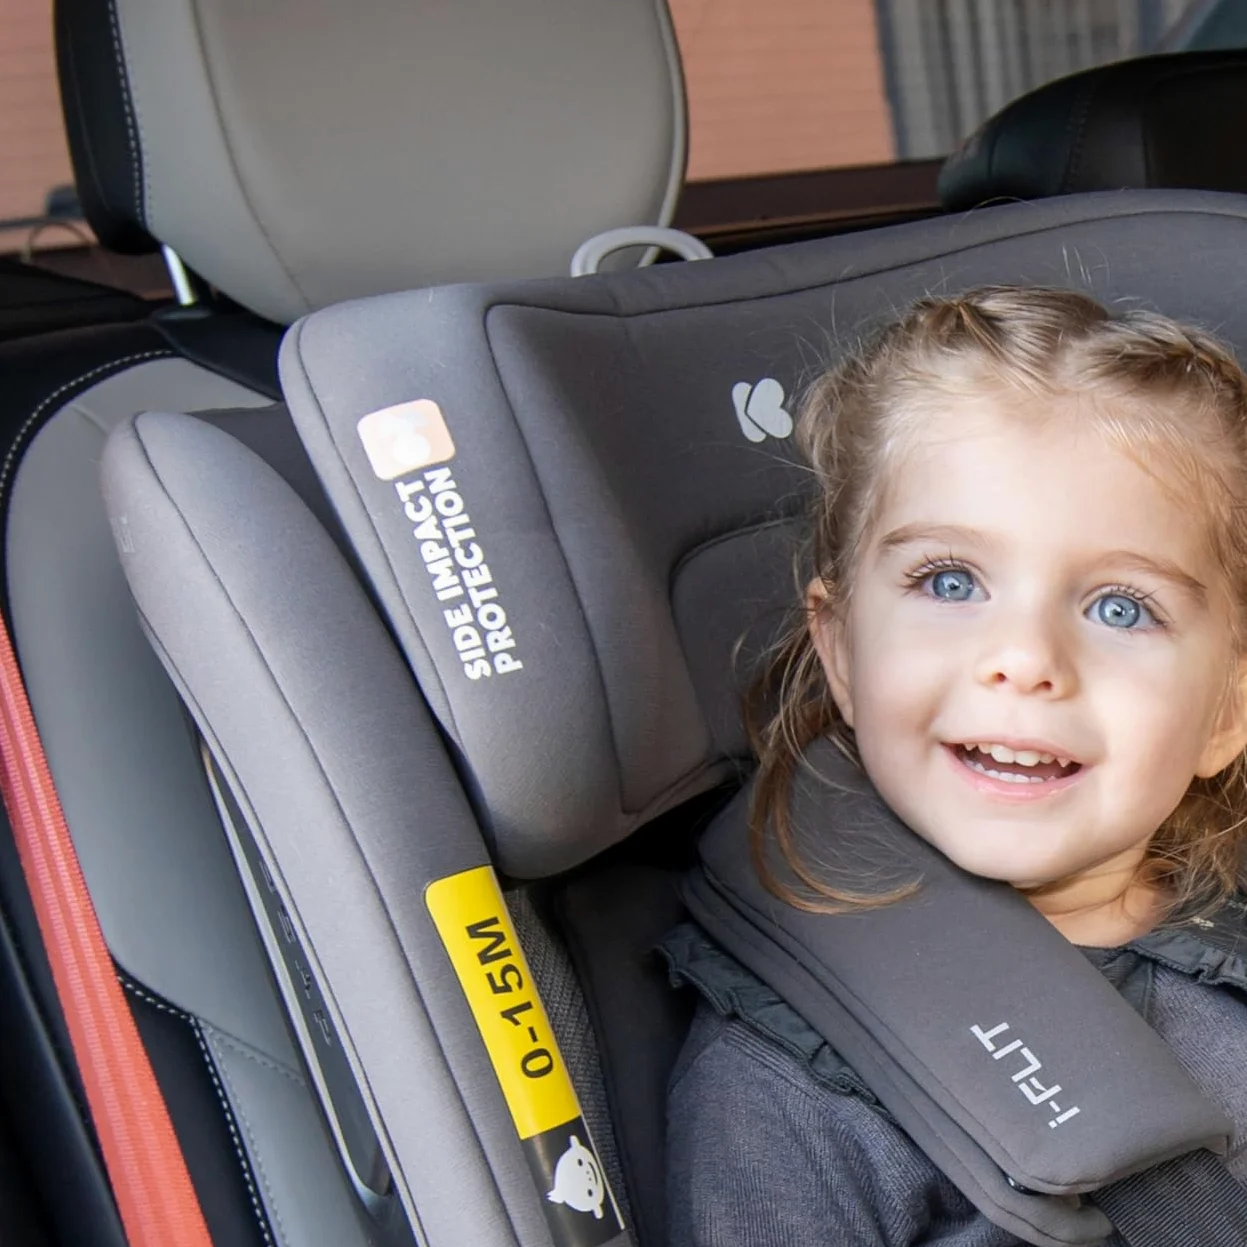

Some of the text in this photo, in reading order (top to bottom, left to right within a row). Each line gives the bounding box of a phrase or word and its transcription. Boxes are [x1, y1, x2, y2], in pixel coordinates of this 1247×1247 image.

[395, 479, 492, 680] SIDE IMPACT
[424, 466, 524, 675] PROTECTION
[465, 916, 555, 1079] 0-15M
